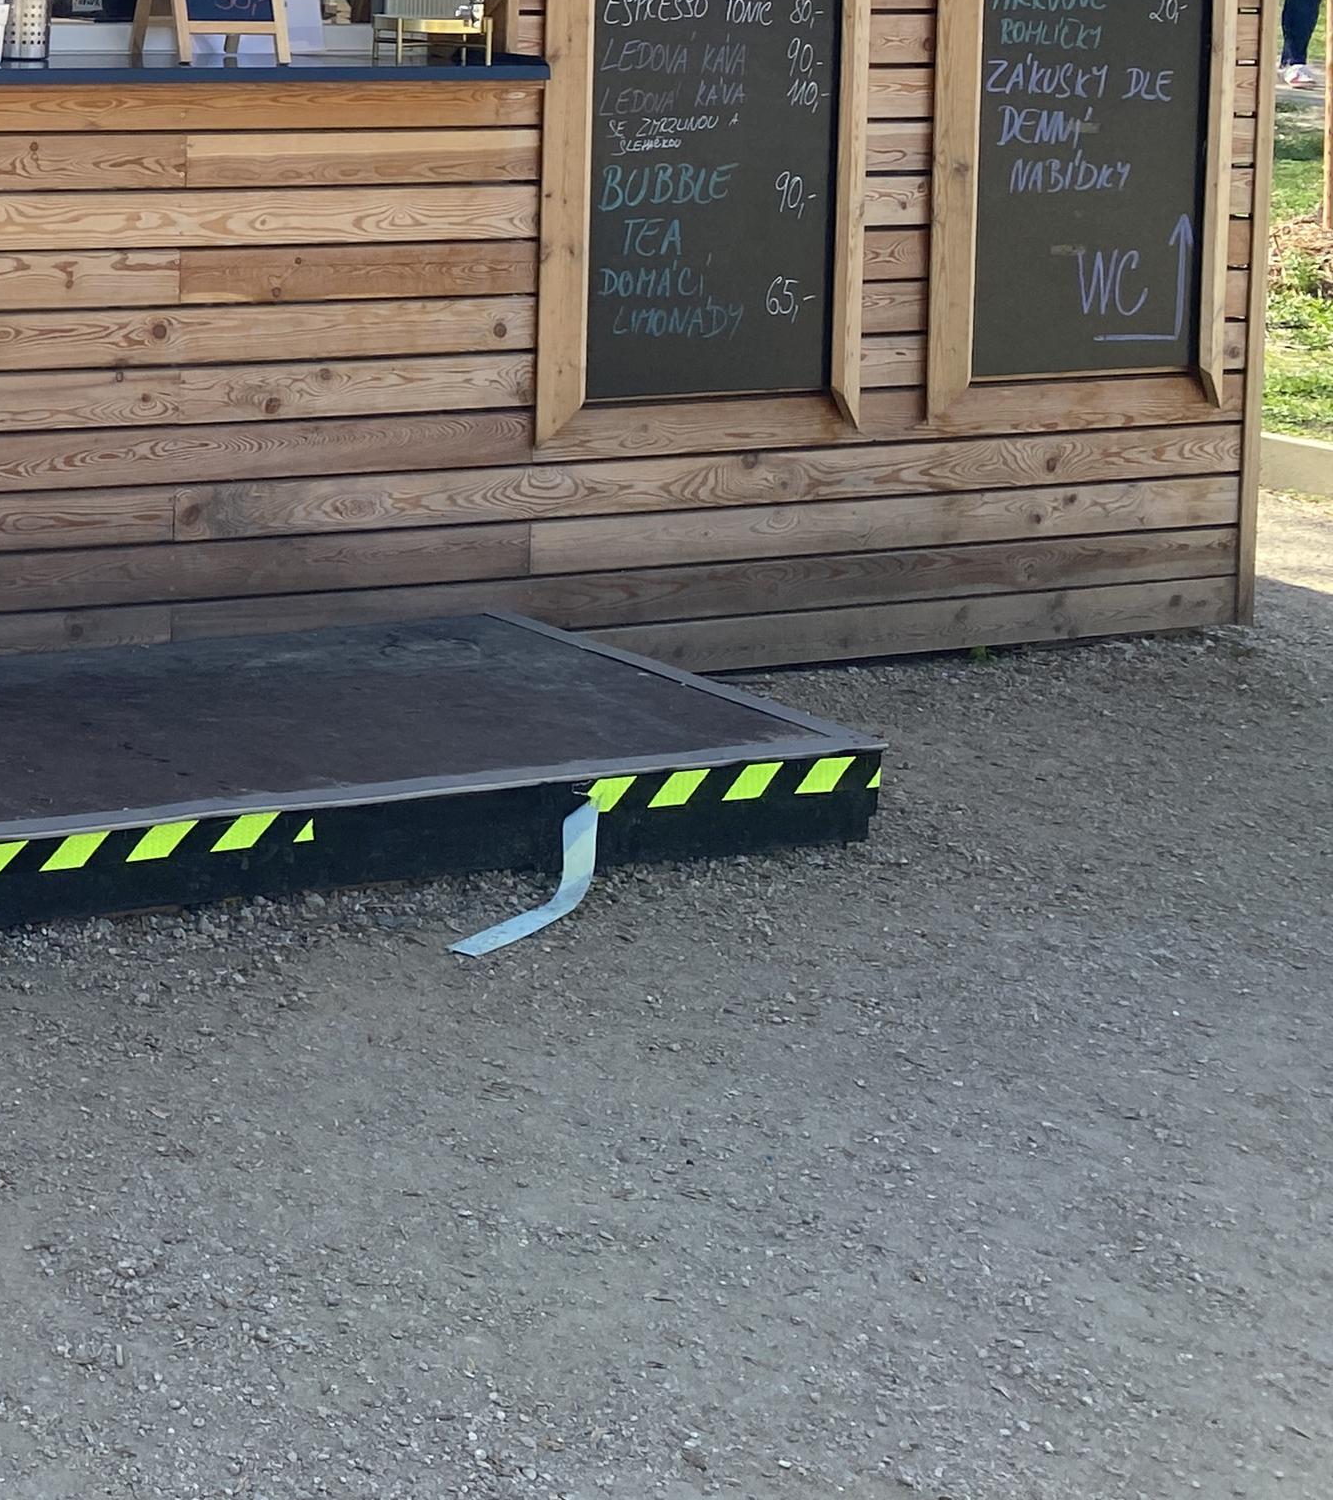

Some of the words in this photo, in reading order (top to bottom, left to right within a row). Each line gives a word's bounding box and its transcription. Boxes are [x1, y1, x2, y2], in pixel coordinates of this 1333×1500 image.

[701, 33, 747, 76] KÁVA
[985, 53, 1109, 99] ZÁKUSKY
[1122, 67, 1174, 102] DLE
[606, 119, 627, 137] SE
[598, 163, 739, 211] BUBBLE
[1009, 149, 1131, 193] NABÍDKY
[624, 218, 682, 256] TEA
[1078, 249, 1148, 316] WC
